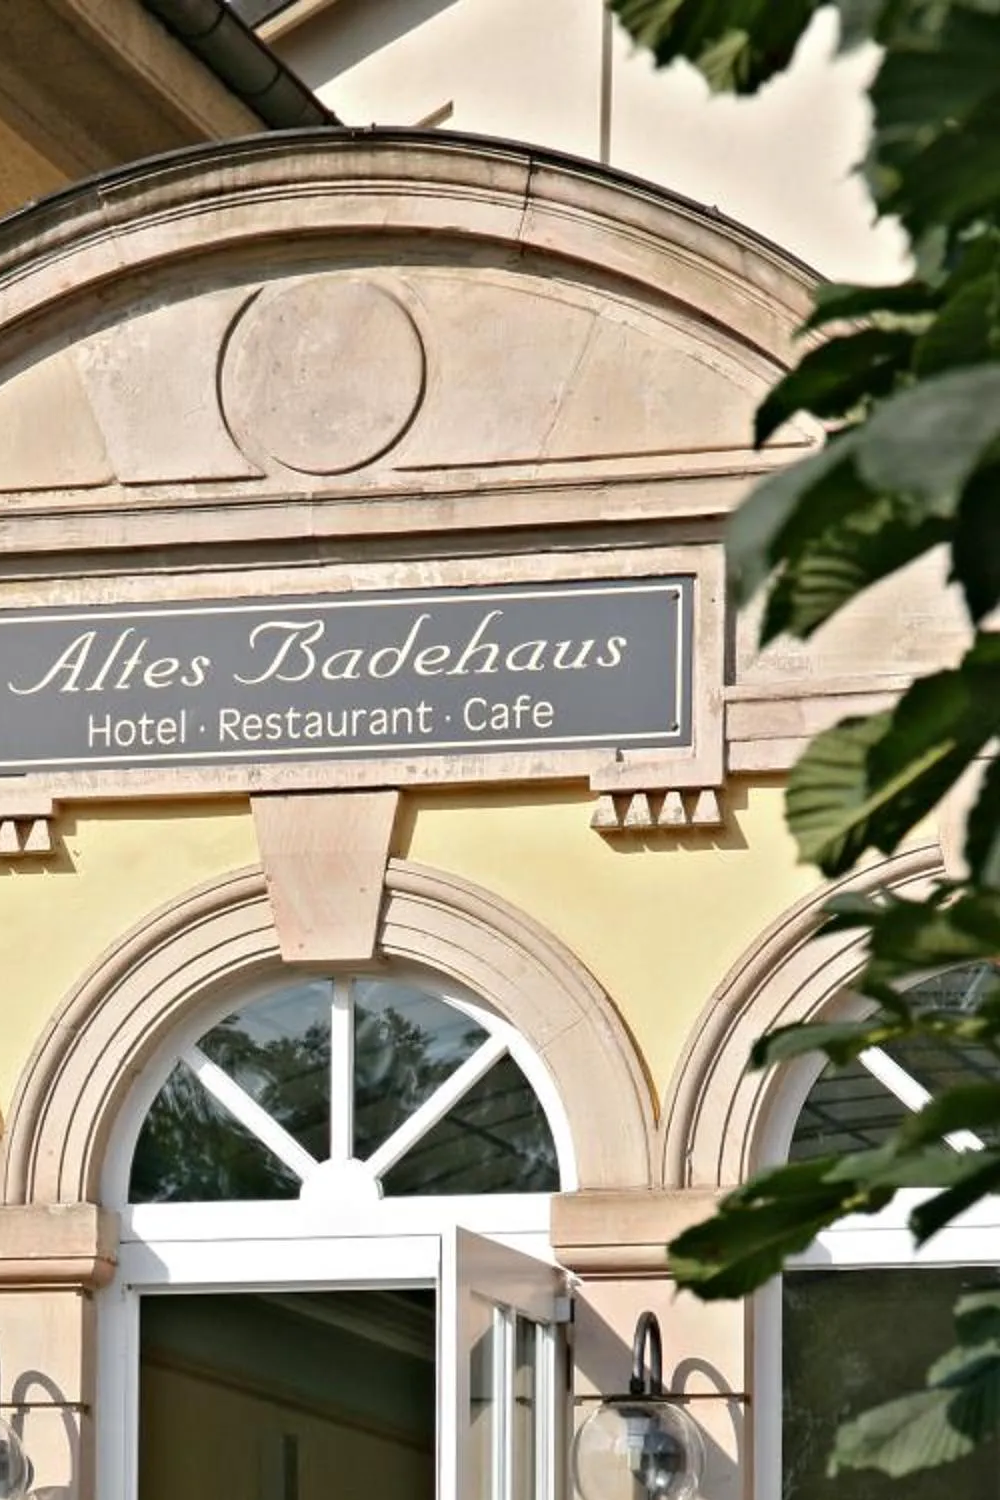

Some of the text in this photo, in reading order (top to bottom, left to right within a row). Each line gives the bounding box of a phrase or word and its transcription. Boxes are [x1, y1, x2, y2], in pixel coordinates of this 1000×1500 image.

[8, 609, 627, 695] Altes Badehaus
[87, 695, 555, 748] Hotel Restaurant Cafe
